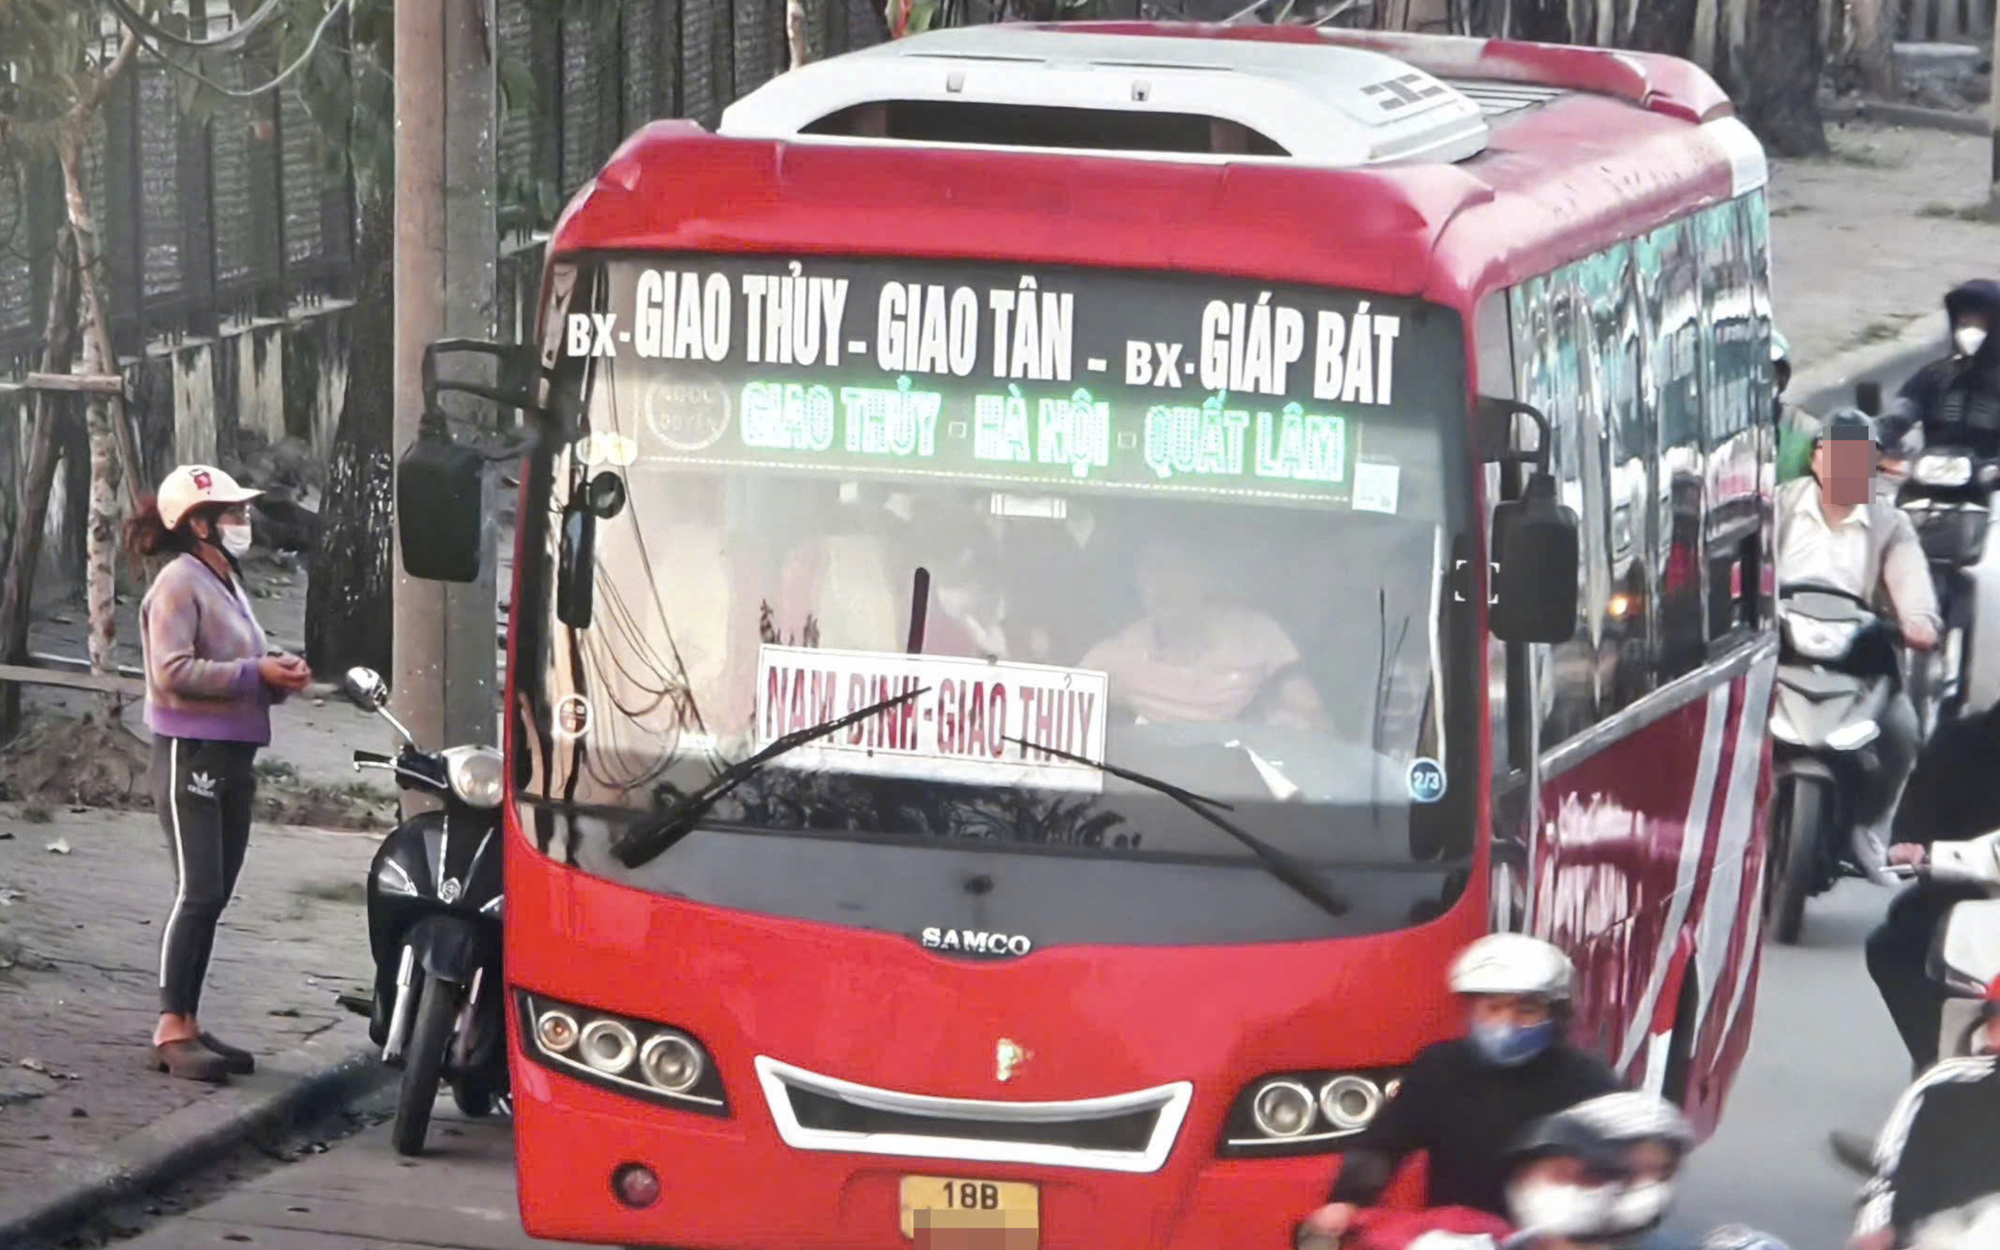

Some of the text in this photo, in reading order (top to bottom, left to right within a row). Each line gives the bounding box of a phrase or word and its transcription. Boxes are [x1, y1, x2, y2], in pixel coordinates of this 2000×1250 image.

[877, 281, 979, 376] GIAO
[989, 275, 1074, 381] TÂN
[1314, 302, 1400, 405] BÁT
[741, 381, 834, 451] GIAO
[840, 375, 942, 456] THỦY
[974, 383, 1031, 462] HÀ
[1037, 387, 1110, 478] NỘI
[1254, 402, 1346, 482] LÂM
[766, 666, 837, 743] NAM
[1019, 673, 1095, 764] THỦY
[1413, 771, 1440, 790] 2/3
[922, 927, 1031, 955] SAMCO
[943, 1181, 999, 1210] 18B
